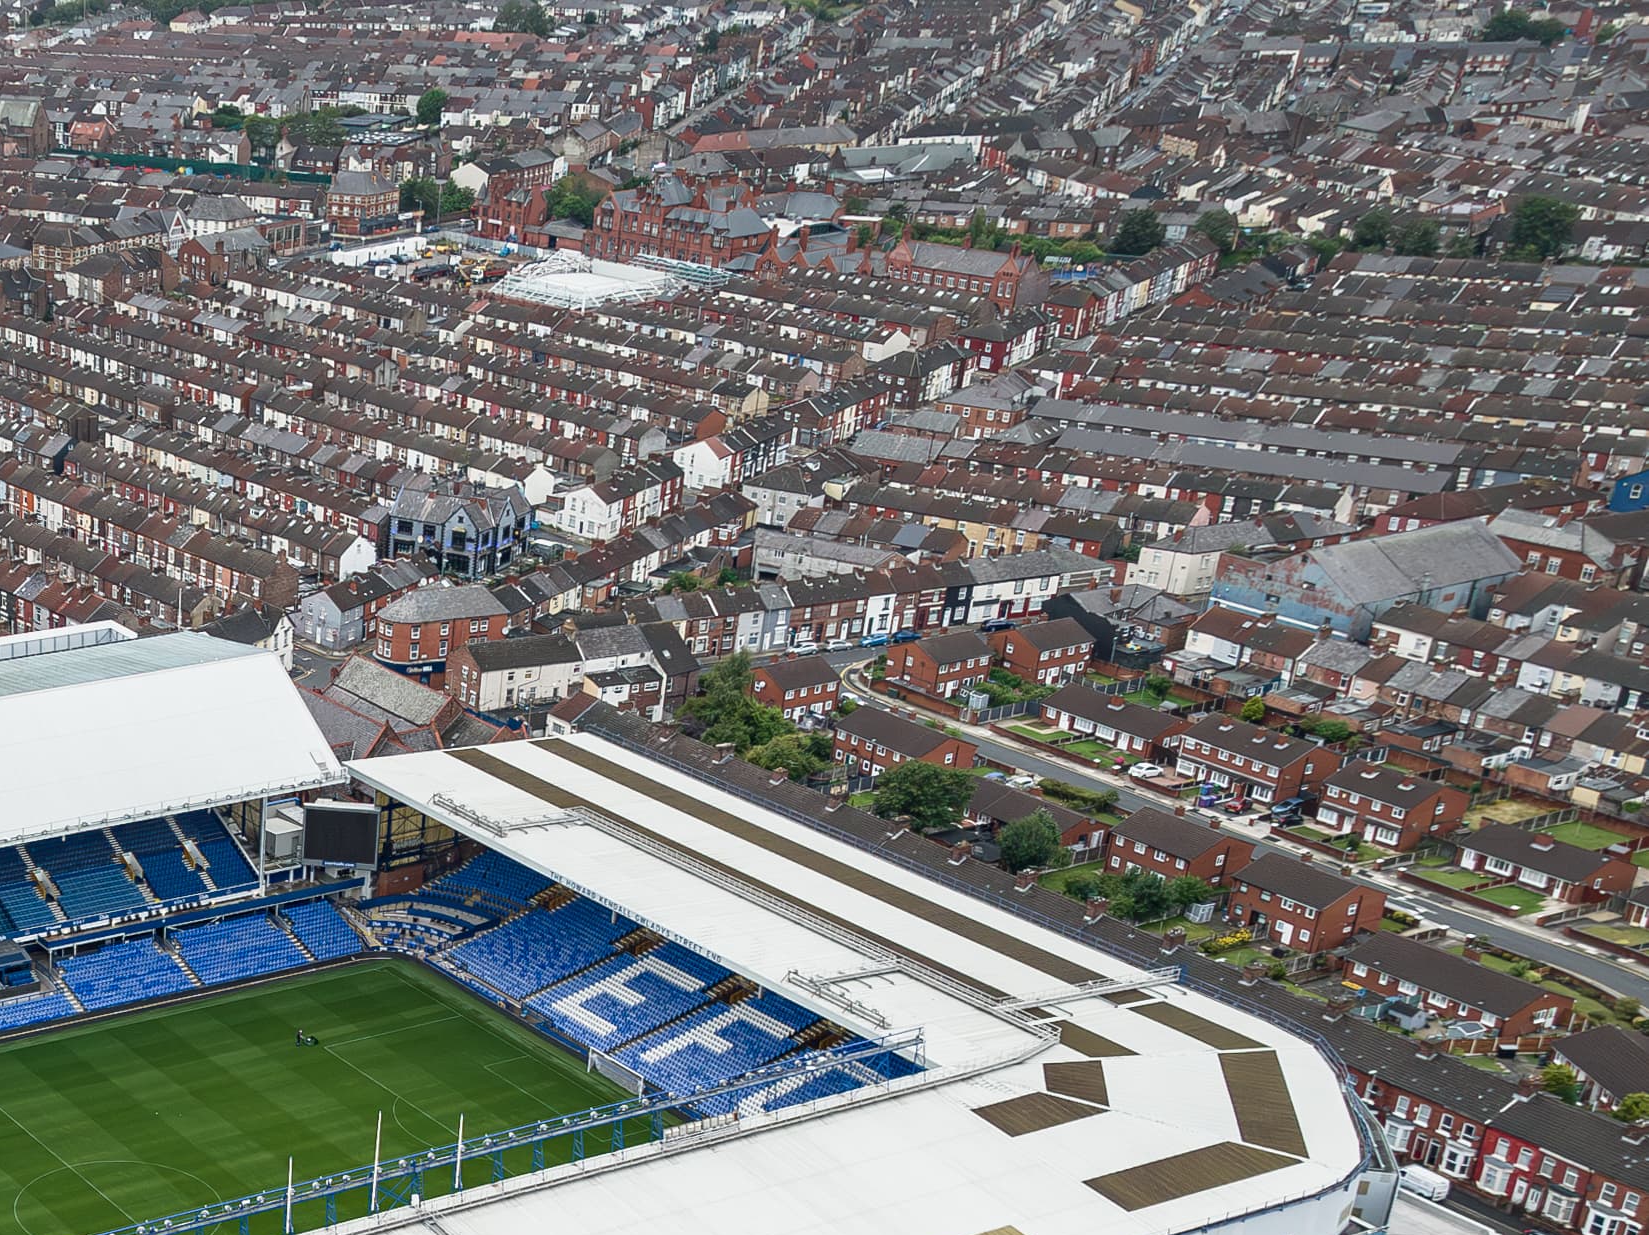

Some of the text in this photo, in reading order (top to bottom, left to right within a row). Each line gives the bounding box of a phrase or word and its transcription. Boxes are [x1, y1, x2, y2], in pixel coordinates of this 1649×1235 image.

[550, 871, 722, 963] THE HOWARD KENDALL GWLADYS STREET END
